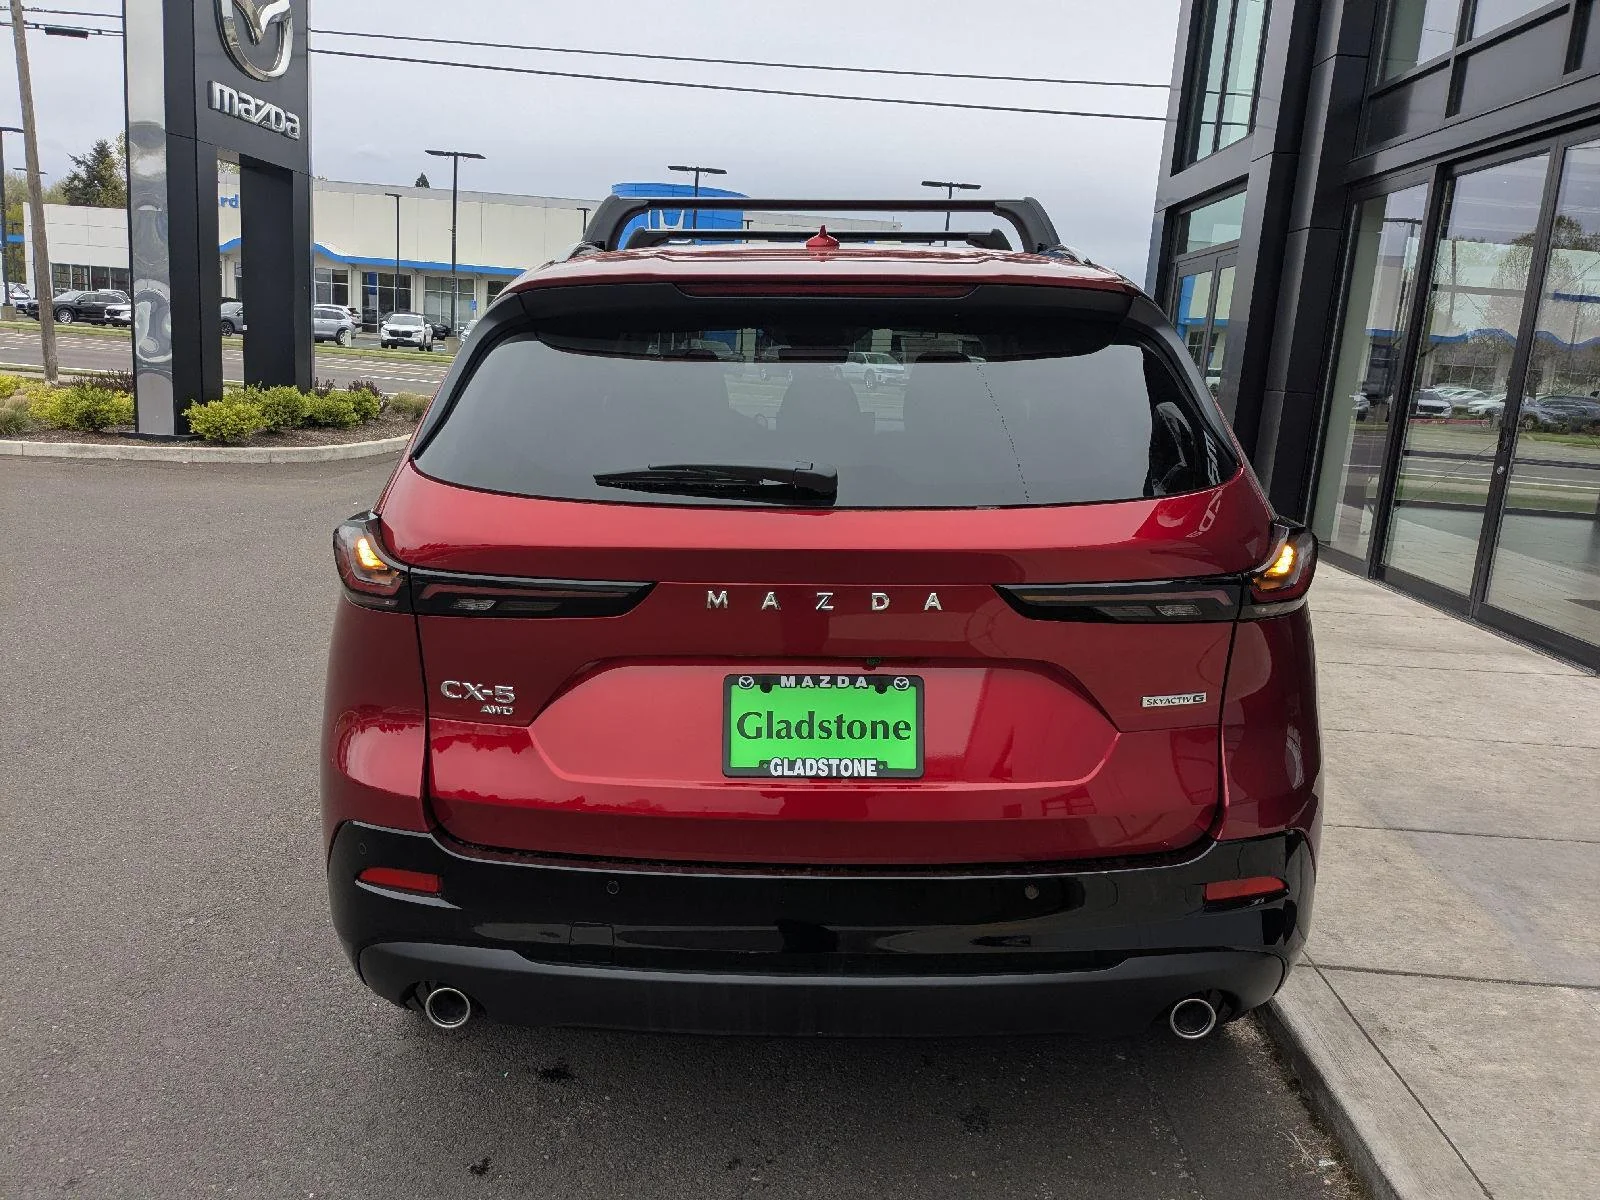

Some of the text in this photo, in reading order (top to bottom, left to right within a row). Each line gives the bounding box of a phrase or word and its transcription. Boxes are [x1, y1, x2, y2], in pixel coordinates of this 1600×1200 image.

[706, 590, 943, 611] MAZDA
[780, 675, 868, 688] MAZDA
[440, 680, 516, 704] CX-5
[480, 704, 514, 715] AWD
[736, 710, 912, 741] Gladstone
[769, 757, 878, 777] GLADSTONE
